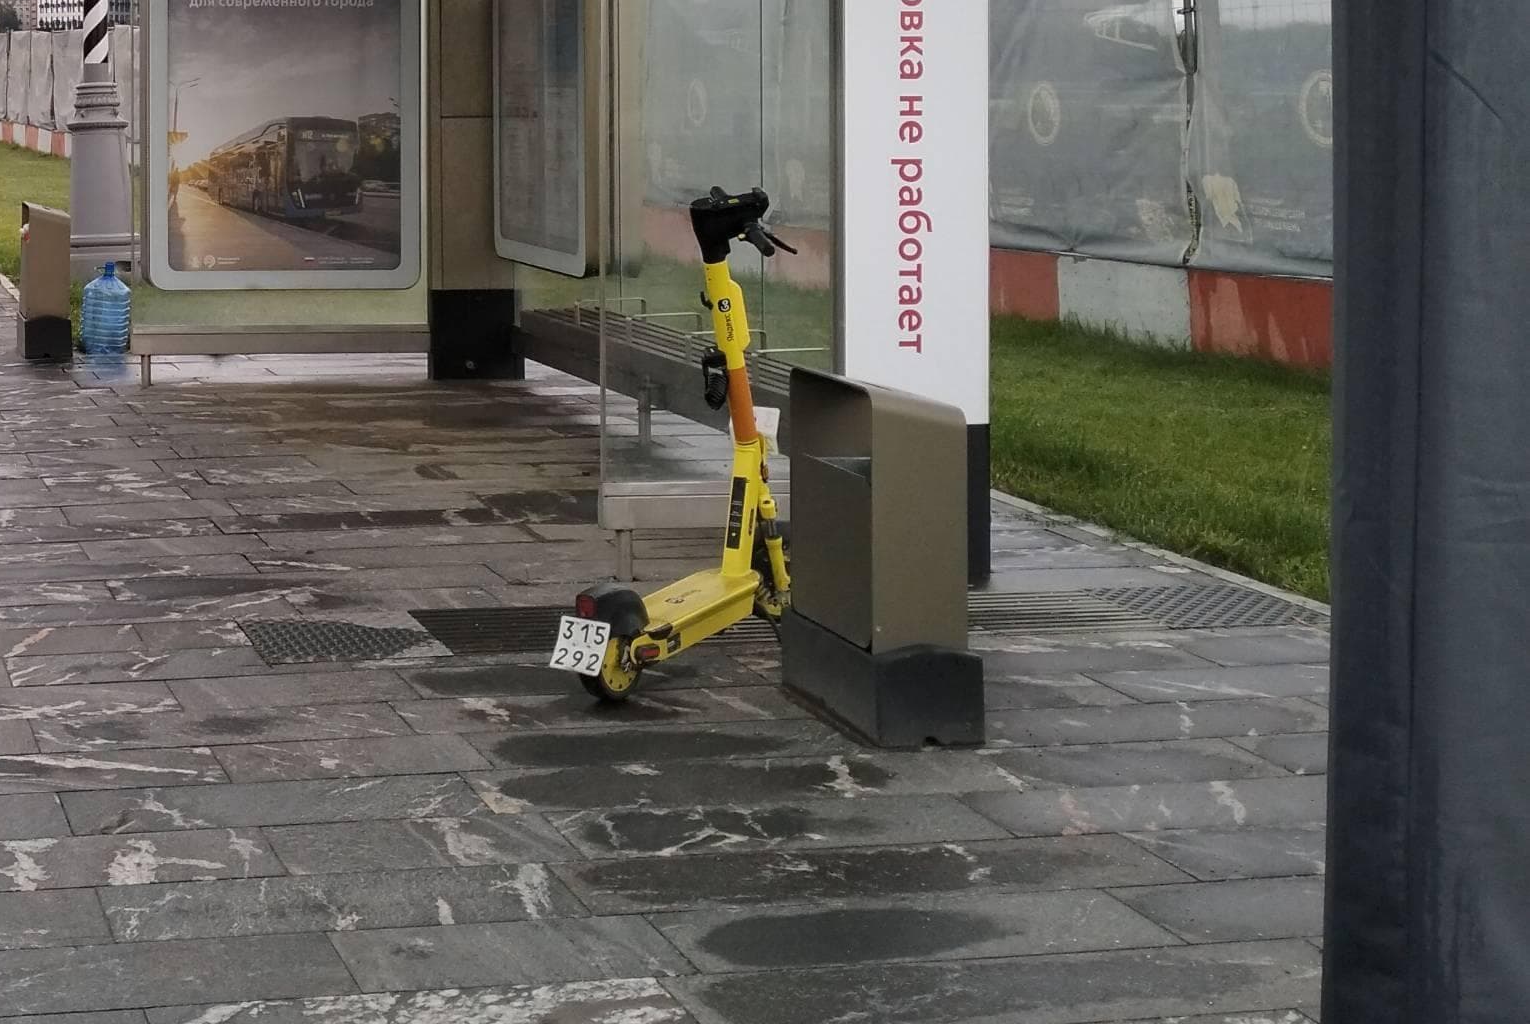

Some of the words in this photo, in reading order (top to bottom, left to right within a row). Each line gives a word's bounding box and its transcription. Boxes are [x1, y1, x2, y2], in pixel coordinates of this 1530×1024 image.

[898, 95, 924, 144] не
[891, 158, 933, 354] работает
[562, 620, 607, 645] 315
[554, 647, 600, 672] 292
